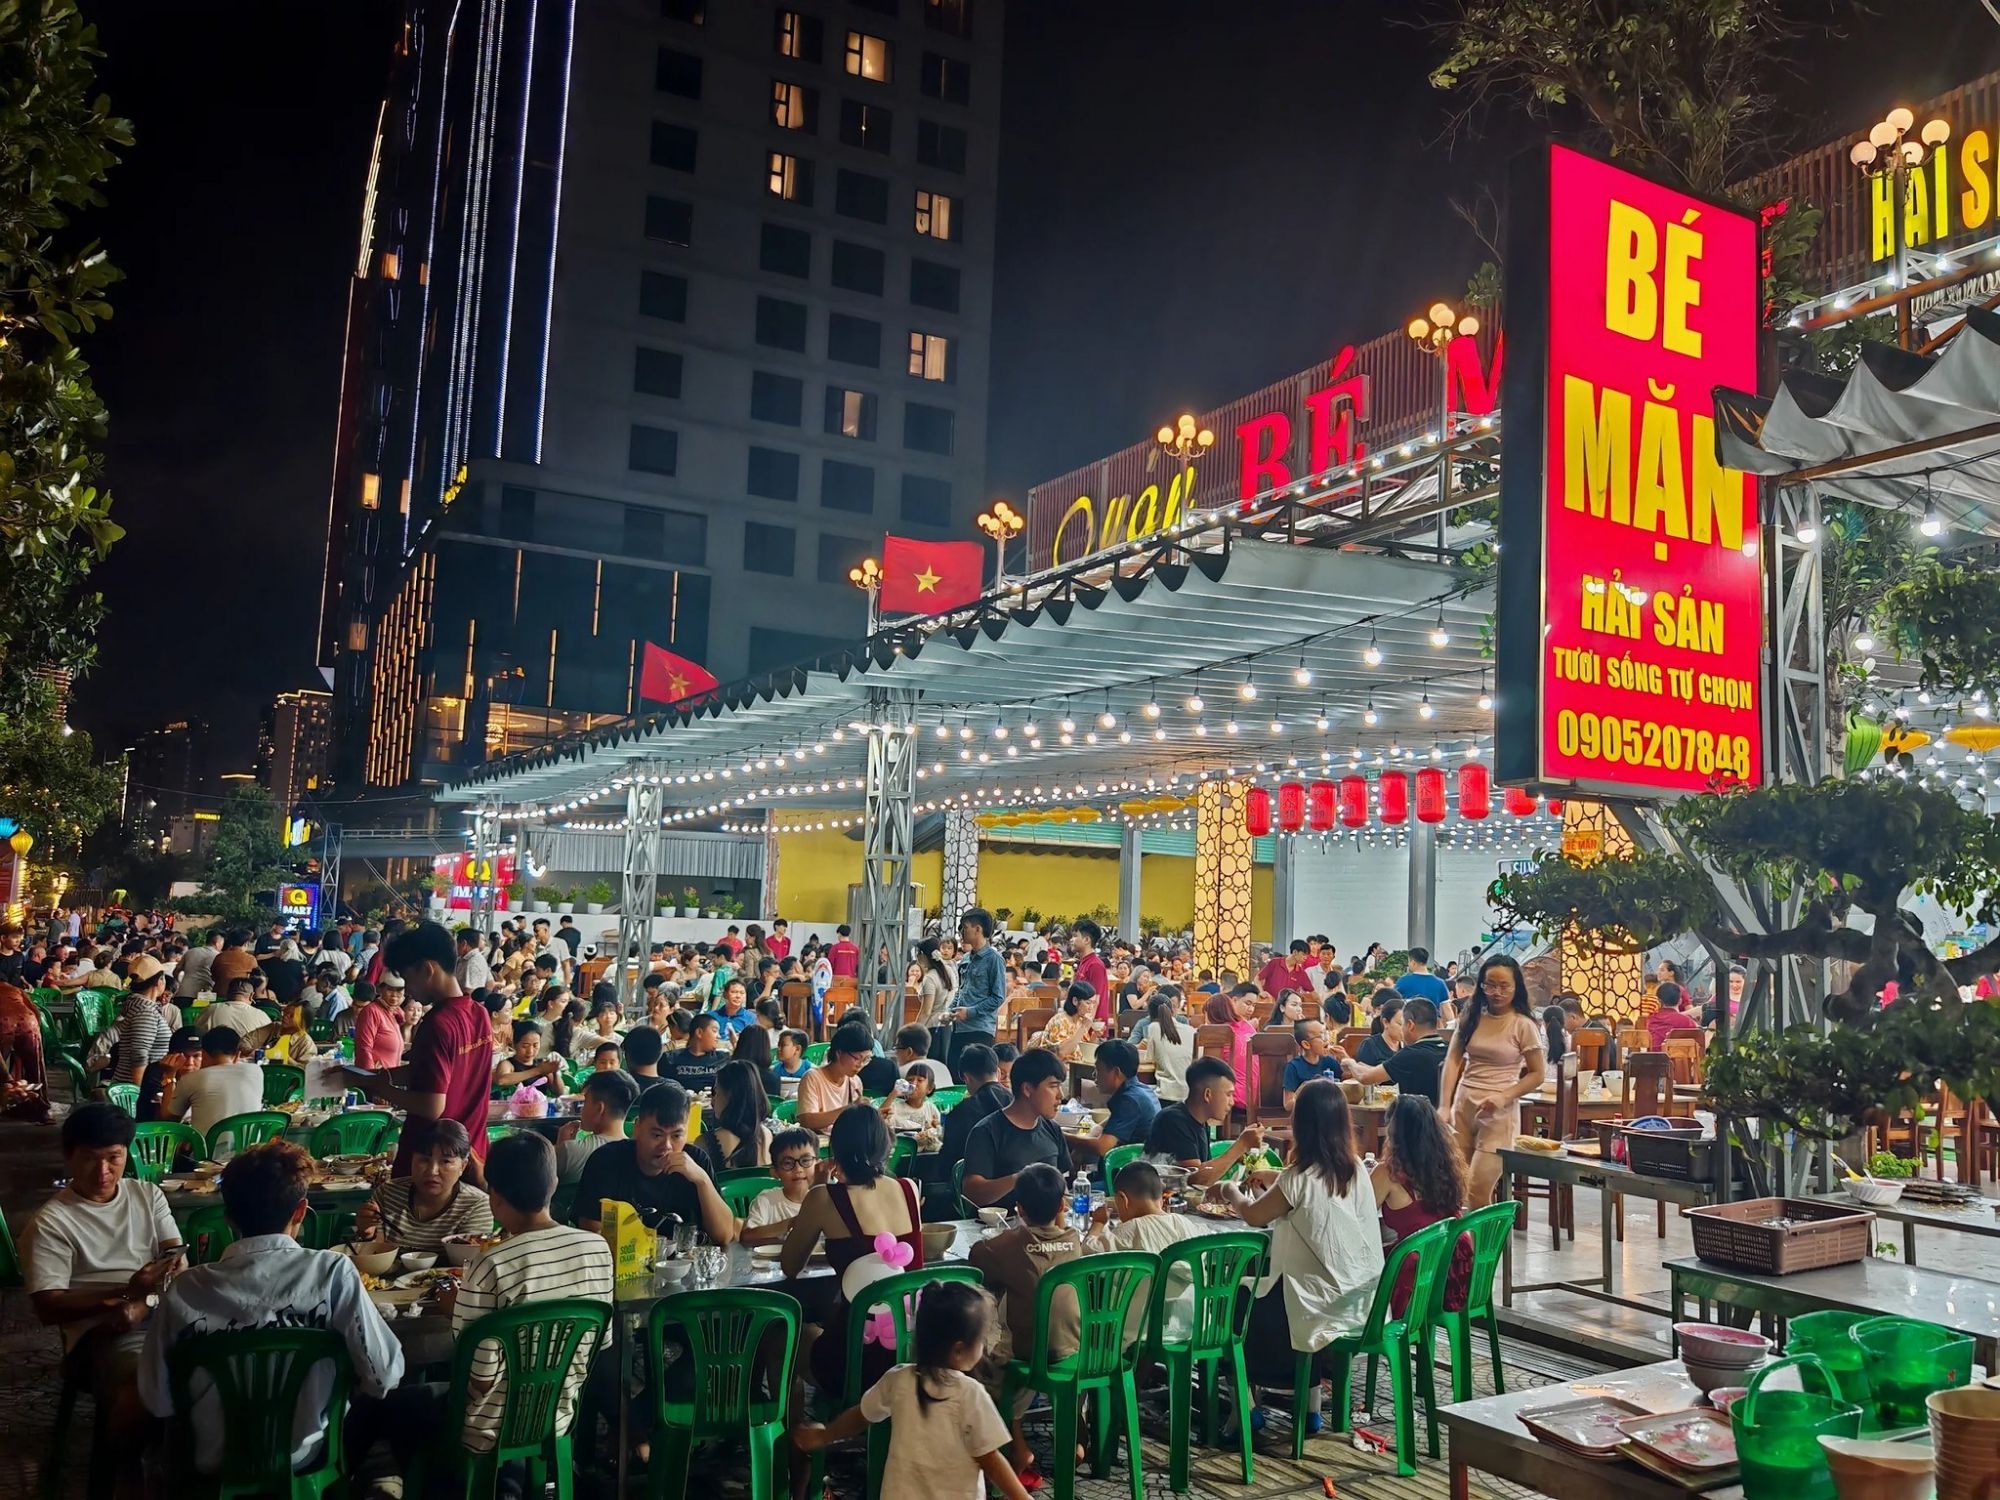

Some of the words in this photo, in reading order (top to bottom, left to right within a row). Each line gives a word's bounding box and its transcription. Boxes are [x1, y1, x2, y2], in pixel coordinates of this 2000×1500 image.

[1961, 130, 2000, 230] S
[1606, 198, 1704, 359] BÉ
[1563, 374, 1744, 562] MẶN
[1581, 568, 1642, 640] HẢI
[1653, 583, 1725, 655] SẢN
[1553, 646, 1601, 685] TƯƠI
[1606, 650, 1663, 695] SỐNG
[1667, 667, 1695, 705] TỰ
[1698, 673, 1753, 713] CHỌN
[1557, 709, 1751, 780] 0905207848
[283, 905, 312, 915] MART
[1026, 1242, 1074, 1253] CONNECT
